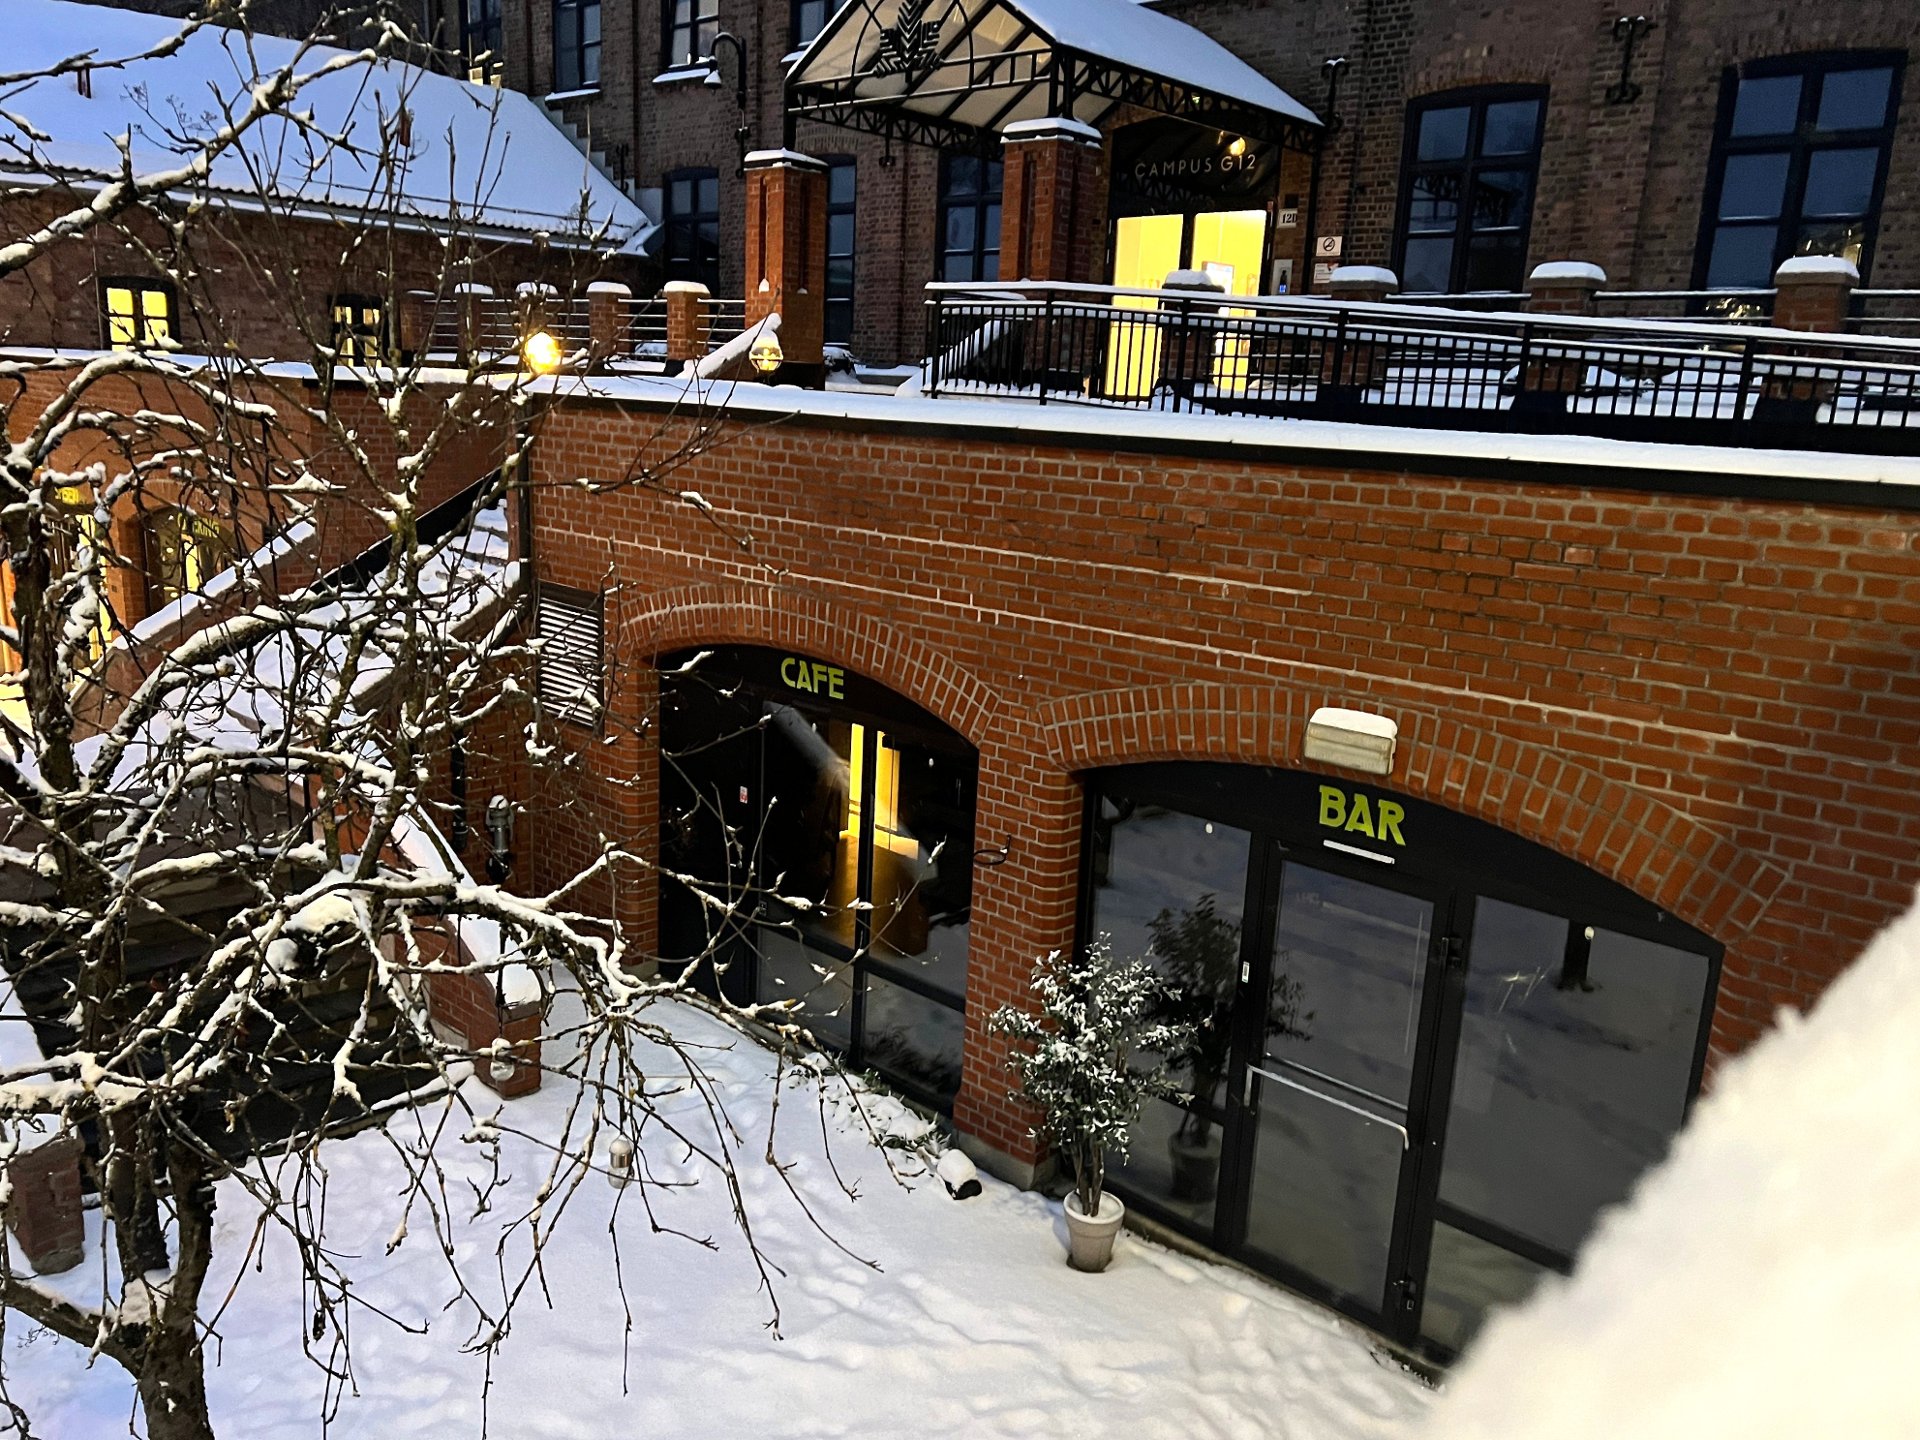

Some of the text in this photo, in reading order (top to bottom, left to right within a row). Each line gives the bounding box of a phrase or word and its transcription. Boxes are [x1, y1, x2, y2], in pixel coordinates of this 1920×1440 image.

[1134, 154, 1256, 178] CAMPUS G12
[780, 657, 845, 700] CAFE
[1318, 784, 1407, 847] BAR
